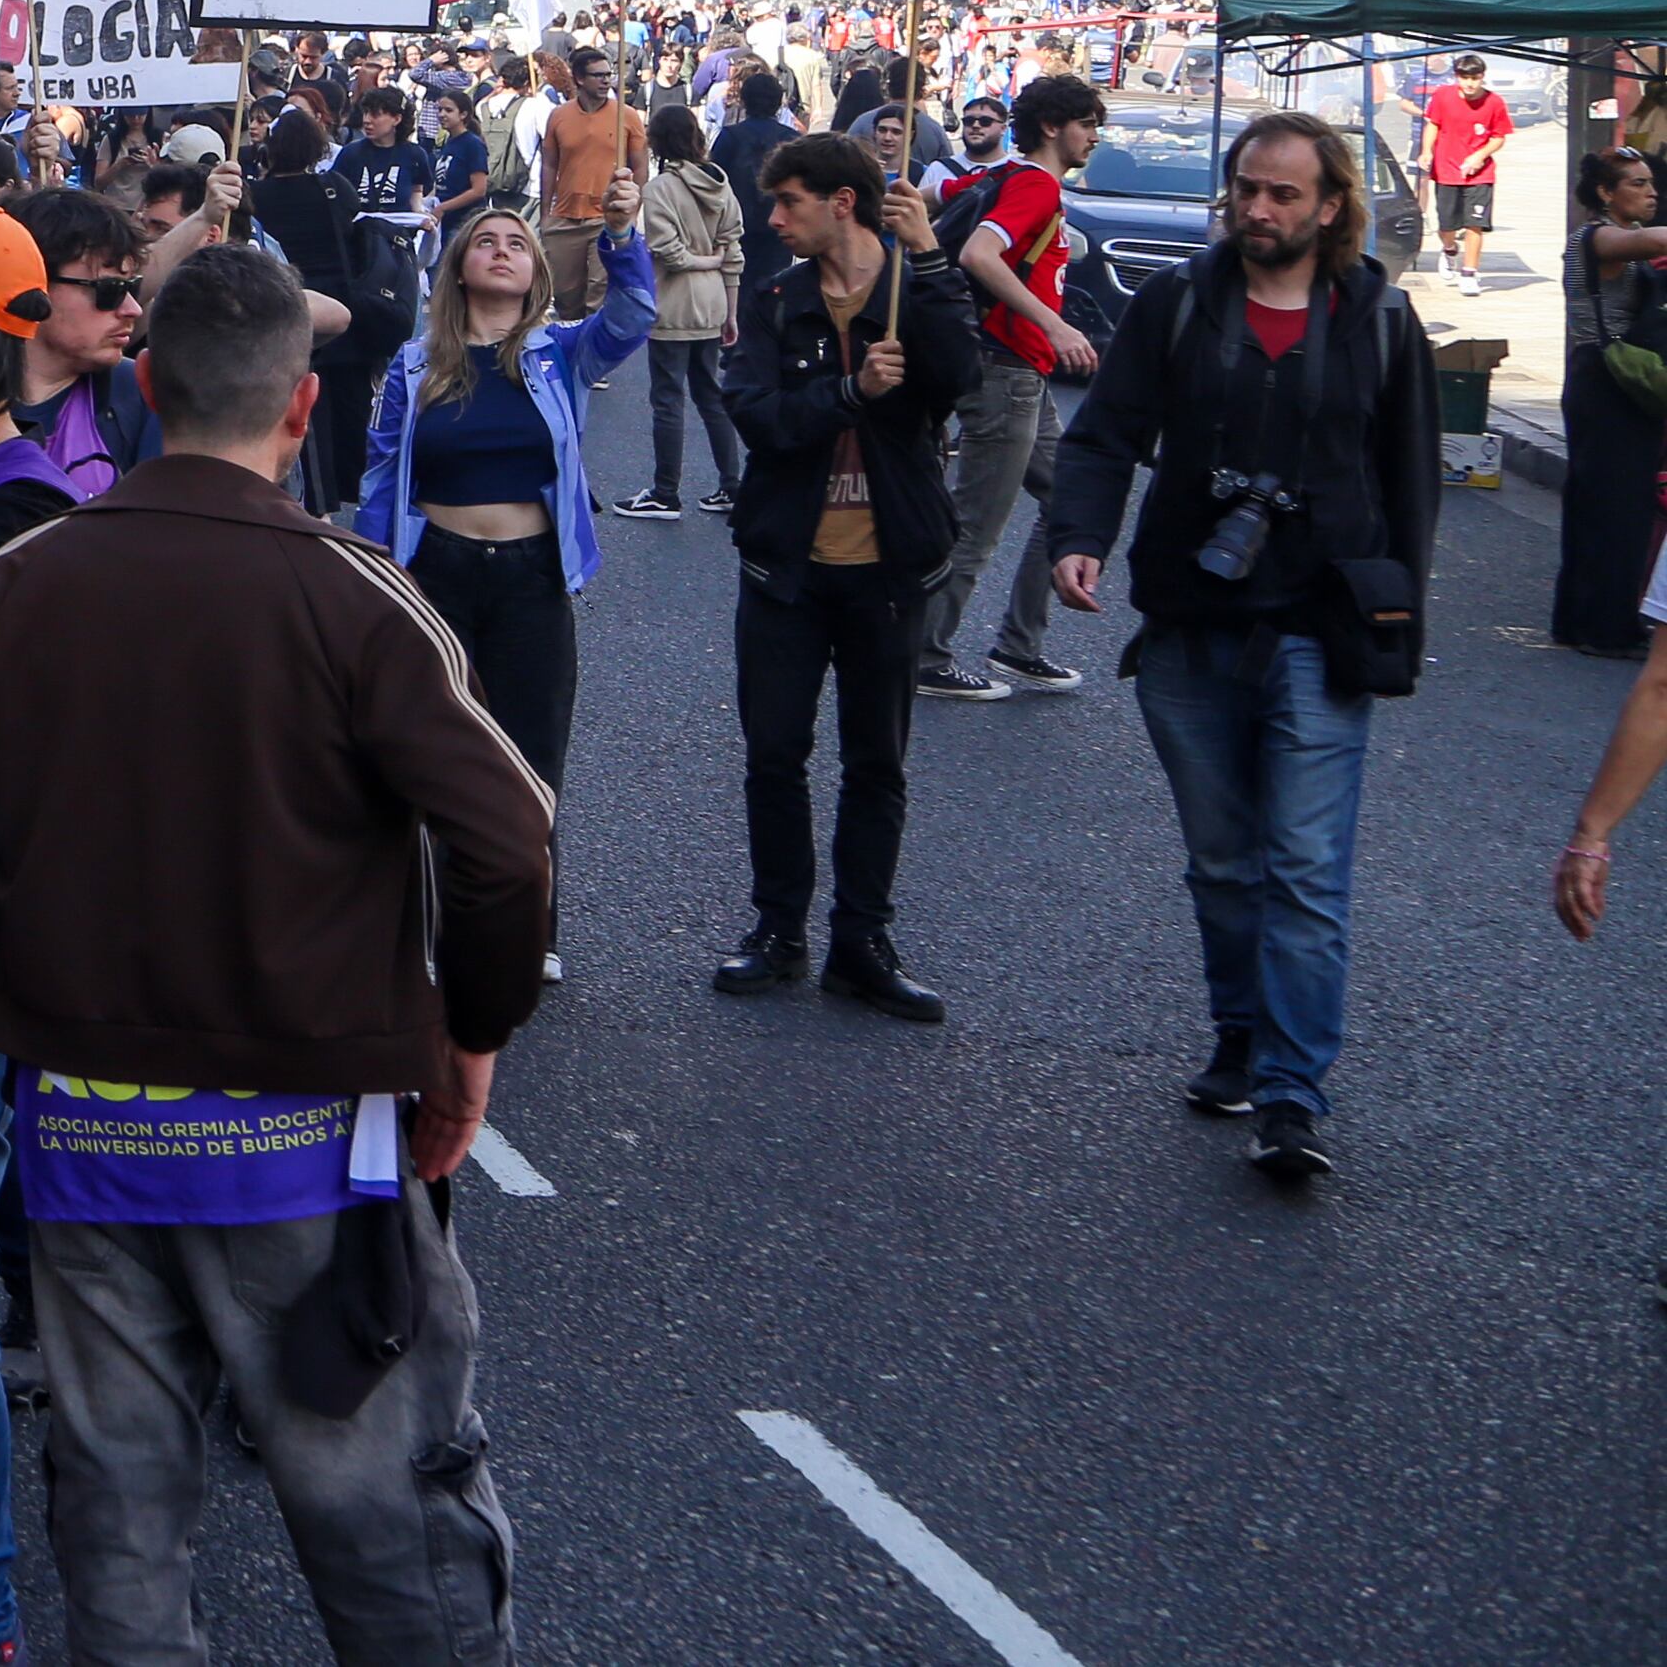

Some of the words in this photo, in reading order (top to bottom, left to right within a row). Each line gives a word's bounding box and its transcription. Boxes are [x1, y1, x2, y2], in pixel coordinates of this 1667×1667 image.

[87, 74, 137, 100] UBA
[36, 1114, 154, 1137] ASOCIACION
[159, 1118, 255, 1138] GREMIAL
[259, 1097, 355, 1133] DOCENTE
[39, 1134, 62, 1152] LA
[66, 1136, 201, 1157] UNIVERSIDAD
[207, 1139, 236, 1156] DE
[242, 1128, 328, 1155] BUENOS
